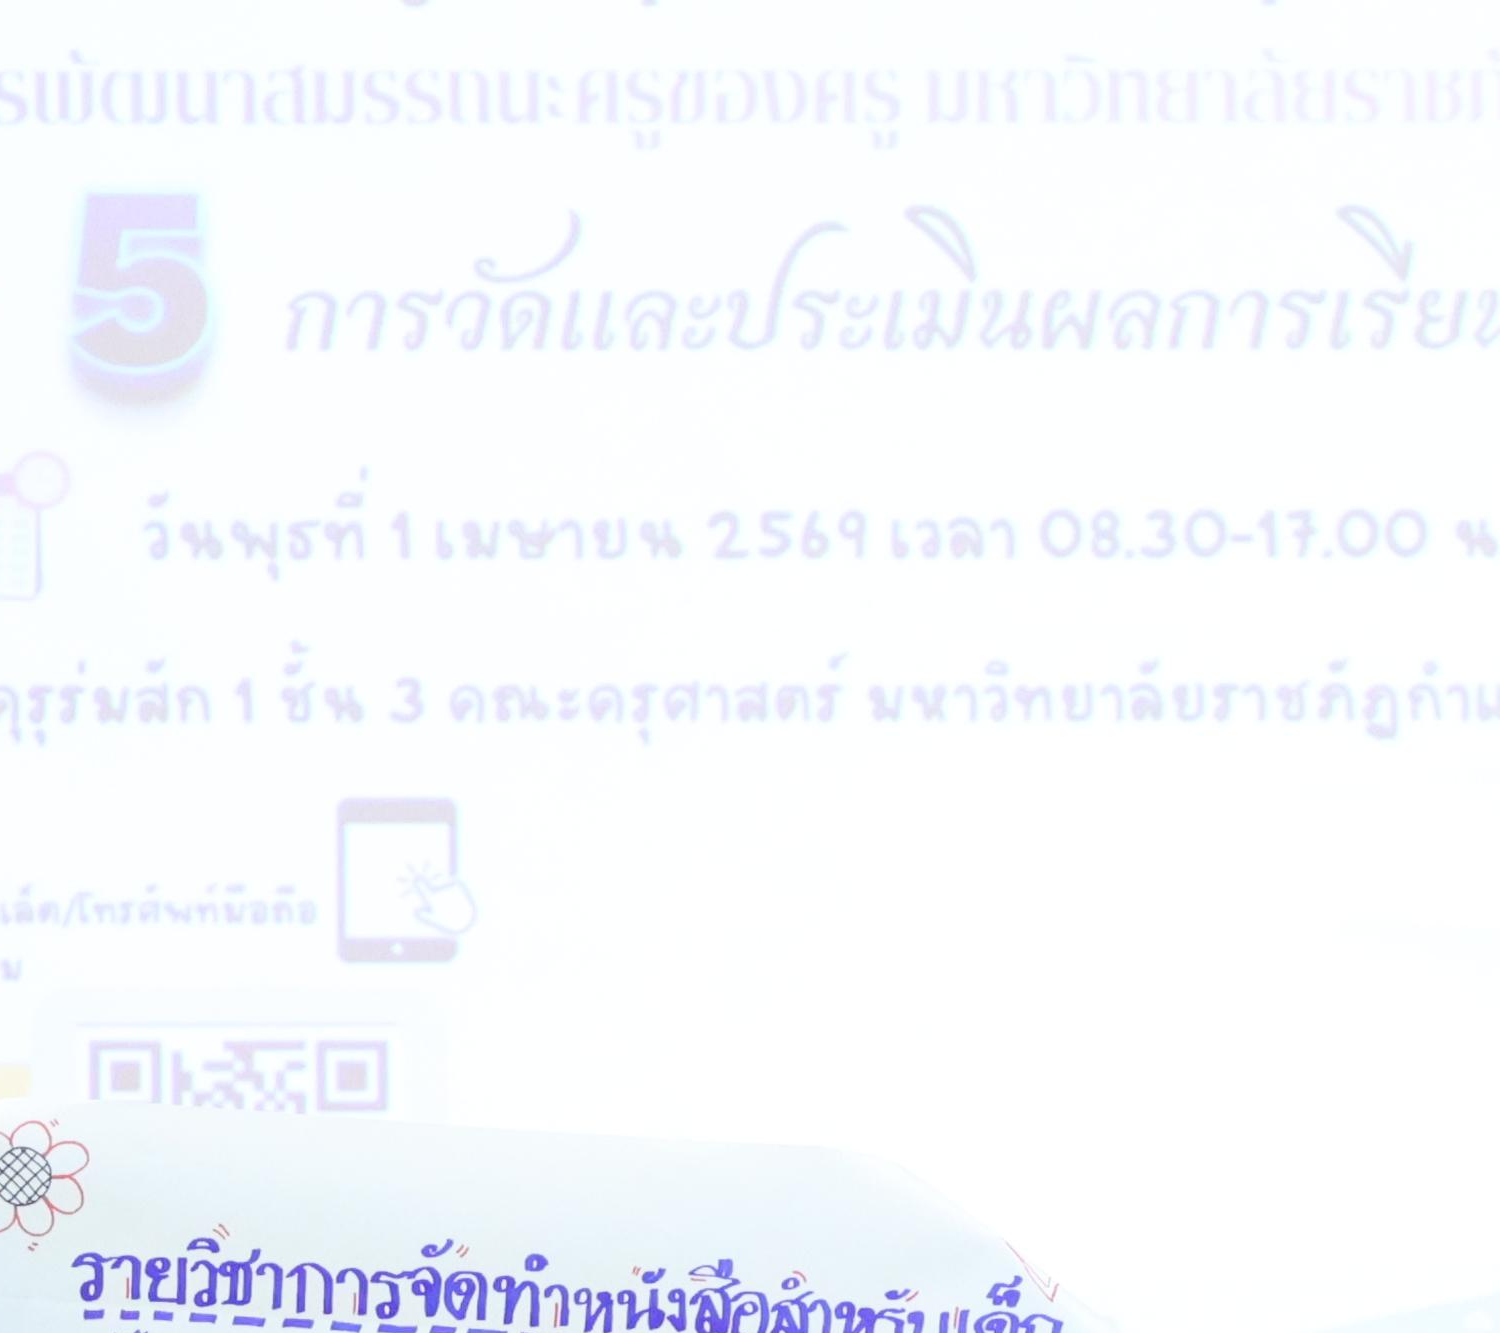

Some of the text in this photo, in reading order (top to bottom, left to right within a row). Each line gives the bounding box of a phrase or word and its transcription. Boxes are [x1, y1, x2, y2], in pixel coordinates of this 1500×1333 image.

[69, 188, 216, 400] 5
[143, 467, 370, 581] วันพุธที่
[391, 510, 416, 562] 1
[435, 508, 687, 564] เมษายน
[707, 507, 870, 562] 2569
[891, 511, 1018, 563] เวลา
[1038, 505, 1431, 563] 08.30-17.00
[236, 676, 260, 726] 1
[280, 642, 367, 727] ชั้น
[390, 675, 428, 726] 3
[448, 650, 849, 749] คณะครุศาสตร์
